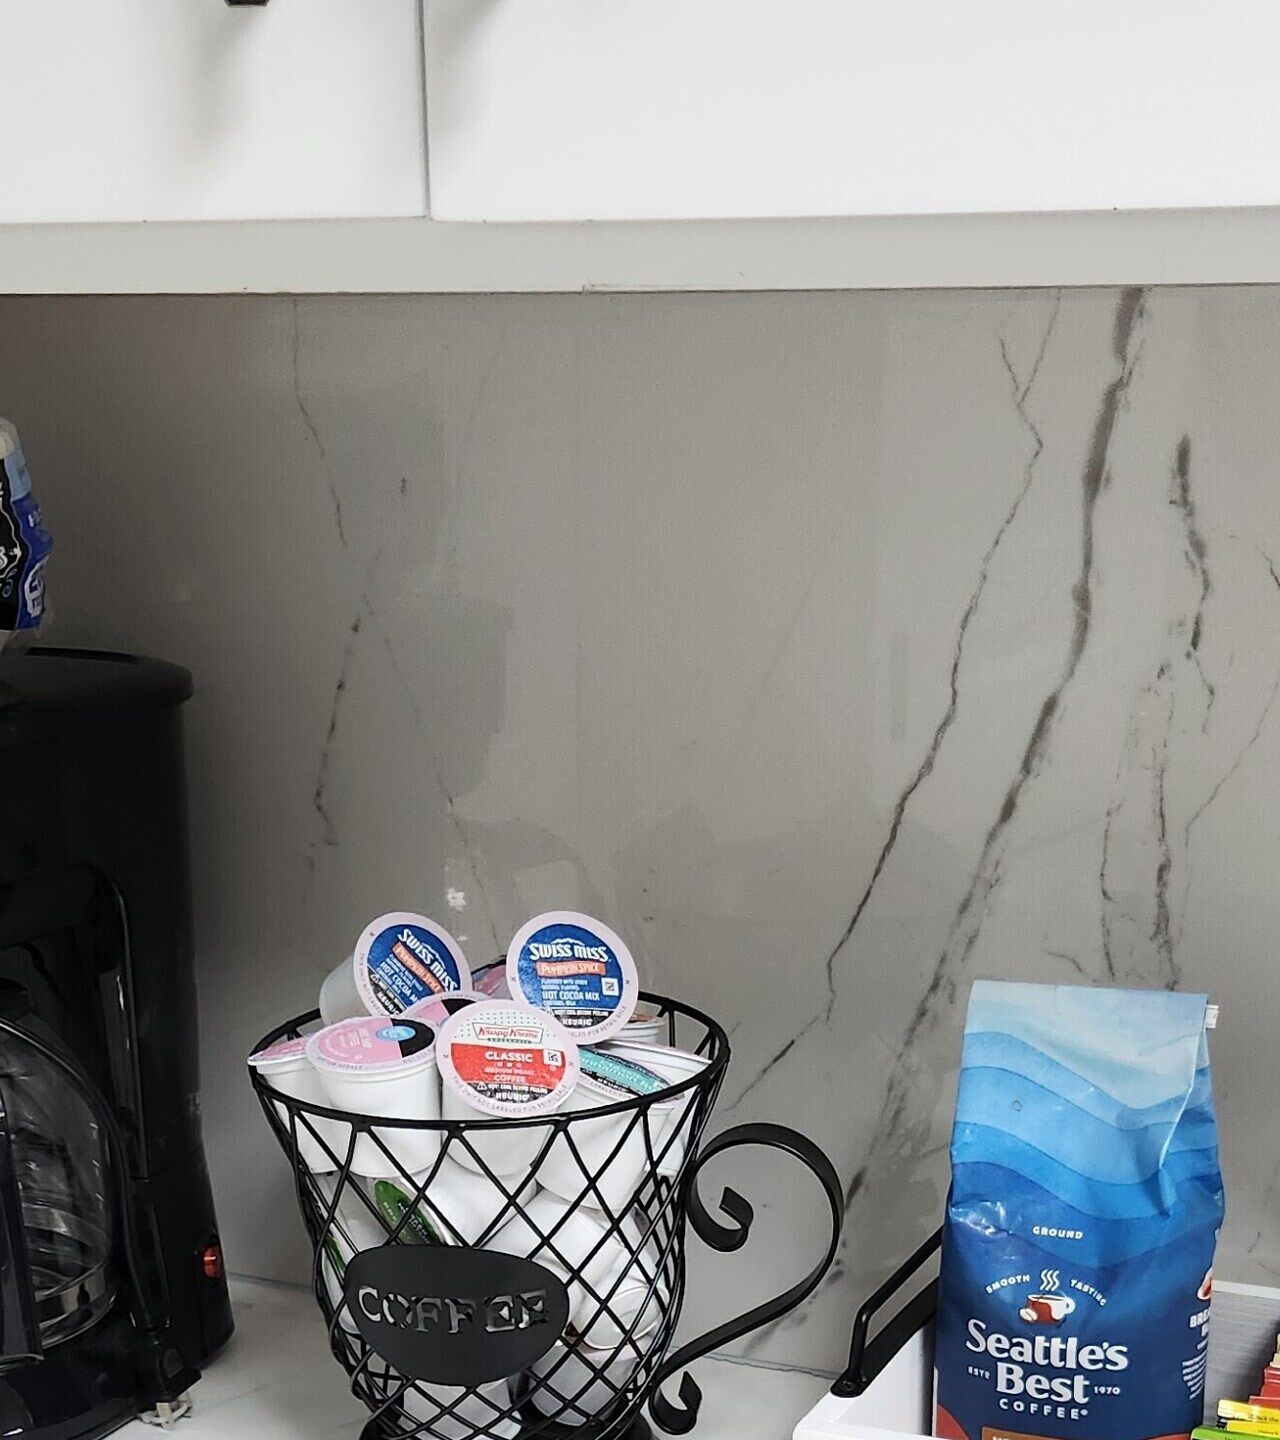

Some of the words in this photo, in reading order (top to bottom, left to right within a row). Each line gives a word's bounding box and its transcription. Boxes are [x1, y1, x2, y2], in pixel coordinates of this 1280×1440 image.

[397, 929, 434, 965] SWISS
[529, 943, 573, 961] SWISS
[573, 945, 609, 963] MISS
[560, 991, 584, 1001] COCOA
[478, 1027, 509, 1037] Krispy
[509, 1028, 539, 1039] Kreme
[484, 1051, 534, 1063] CLASSIC
[1032, 1226, 1083, 1240] GROUND
[985, 1274, 1031, 1294] SMOOTH
[1070, 1279, 1107, 1307] TASTING
[357, 1285, 552, 1335] COFFEE
[965, 1319, 1129, 1371] Seattle's
[995, 1361, 1090, 1404] Best
[1094, 1386, 1120, 1395] 1970
[999, 1398, 1080, 1420] COFFEE
